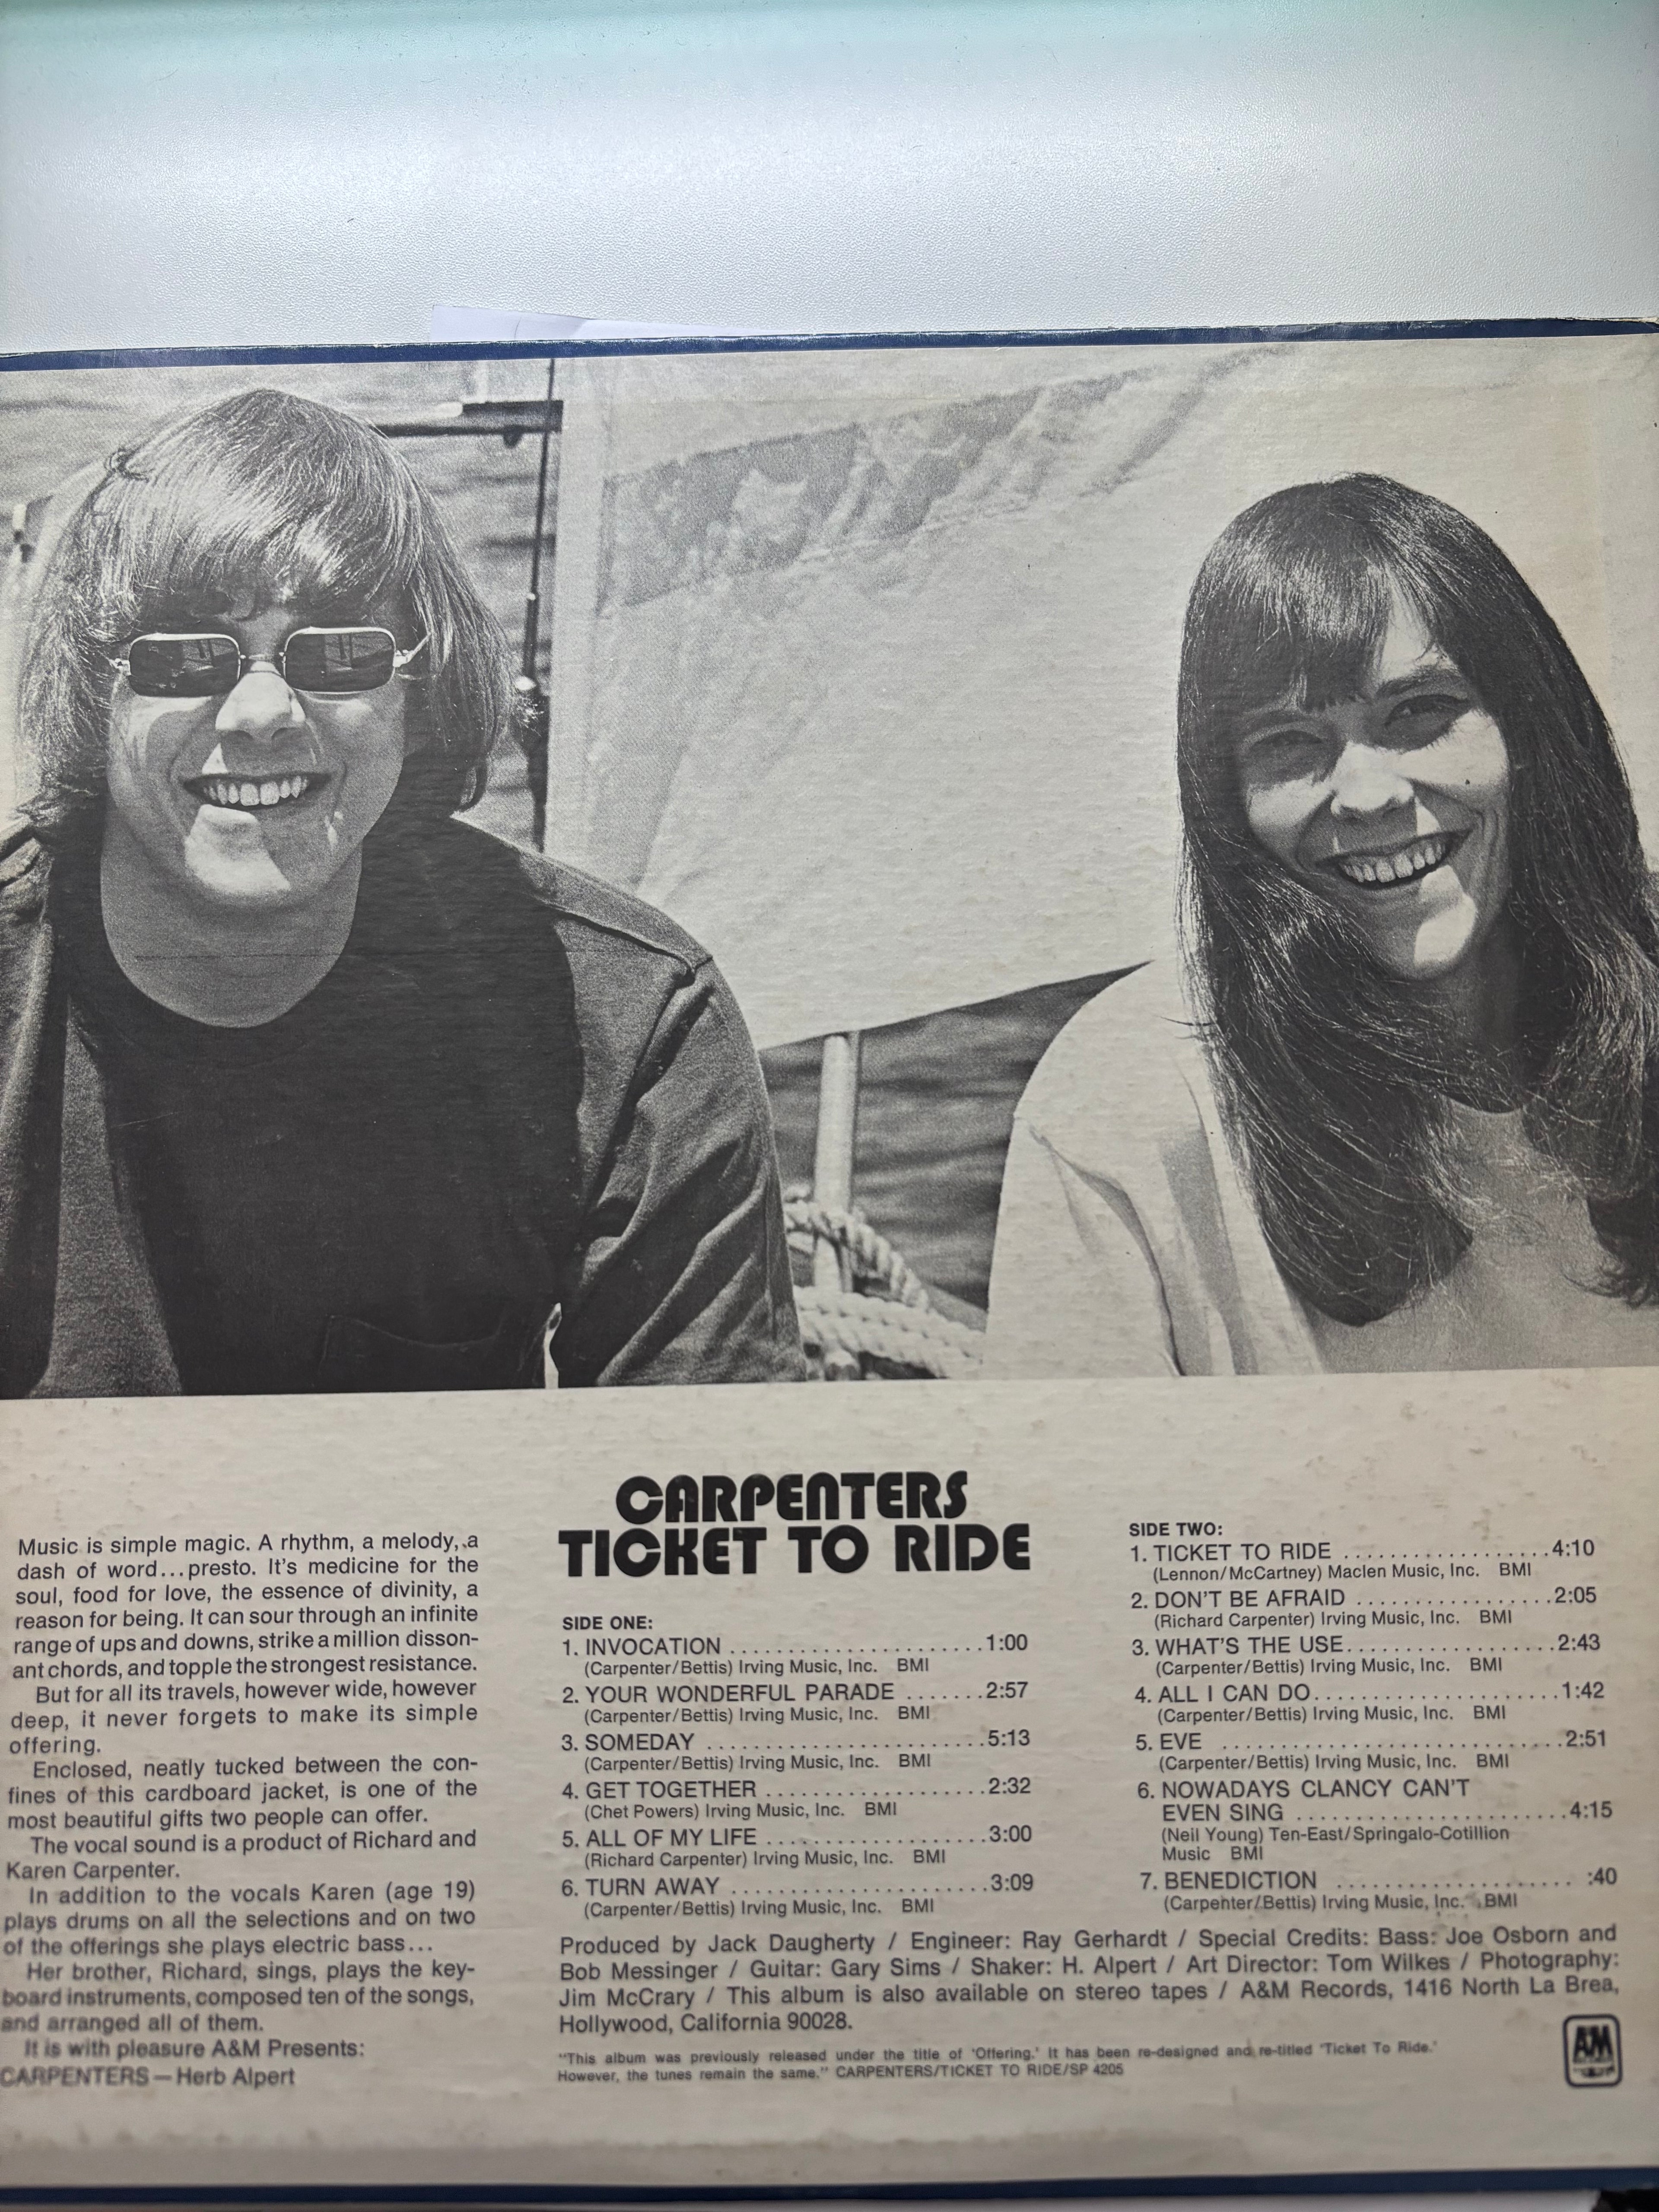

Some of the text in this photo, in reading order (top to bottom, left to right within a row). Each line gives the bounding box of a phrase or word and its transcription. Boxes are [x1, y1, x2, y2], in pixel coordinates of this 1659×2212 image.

[616, 1471, 967, 1525] CARPENTERS
[1129, 1522, 1223, 1537] SIDE TWO:
[19, 1531, 478, 1557] Music is simple magic. A rhythm, a melody, a
[558, 1523, 1030, 1577] TICKET TO RIDE
[1131, 1539, 1595, 1562] 1. TICKET TO RIDE 4:10
[1328, 1564, 1386, 1579] Maclen
[1392, 1563, 1444, 1580] Music,
[1450, 1563, 1479, 1577] Inc.
[1499, 1562, 1531, 1576] BMI
[1131, 1586, 1597, 1609] 2. DON'T BE AFRAID 2:05
[15, 1604, 478, 1630] reason for being. It can sour through an infinite
[562, 1615, 653, 1631] SIDE ONE:
[562, 1634, 1028, 1656] 1. INVOCATION 1:00
[1132, 1639, 1149, 1656] 3.
[1155, 1637, 1239, 1656] WHAT'S
[1247, 1636, 1291, 1654] THE
[1558, 1633, 1601, 1651] 2:43
[36, 1679, 477, 1703] But for all its travels, however wide, however
[562, 1681, 1029, 1704] 2. YOUR WONDERFUL PARADE 2:57
[1134, 1686, 1151, 1703] 4.
[1158, 1685, 1199, 1703] ALL
[1208, 1685, 1212, 1702] I
[1223, 1684, 1268, 1702] CAN
[1562, 1681, 1605, 1699] 1:42
[561, 1729, 1030, 1751] 3. SOMEDAY 5:13
[1136, 1729, 1605, 1751] 5. EVE 2:51
[33, 1754, 478, 1780] Enclosed, neatly tucked between the con-
[562, 1777, 1031, 1799] 4. GET TOGETHER 2:32
[1137, 1778, 1470, 1799] 6. NOWADAYS CLANCY CAN'T
[585, 1801, 897, 1822] (Chet Powers) Irving Music, Inc. BMI
[1163, 1800, 1613, 1822] EVEN SING 4:15
[562, 1824, 1032, 1849] 5. ALL OF MY LIFE 3:00
[1162, 1825, 1510, 1845] (Neil Young) Ten-East/Springalo-Cotillion
[30, 1879, 475, 1904] In addition to the vocals Karen (age 19)
[561, 1873, 1034, 1897] 6. TURN AWAY 3:09
[1140, 1872, 1157, 1890] 7.
[1165, 1871, 1316, 1890] BENEDICTION
[561, 1923, 1617, 1958] Produced by Jack Daugherty / Engineer: Ray Gerhardt / Special Credits: Bass: Joe Osborn and
[559, 2011, 853, 2037] Hollywood, California 90028.
[558, 2070, 619, 2083] However,
[627, 2069, 648, 2082] the
[655, 2070, 692, 2081] tunes
[700, 2069, 746, 2081] remain
[753, 2067, 774, 2079] the
[1000, 2064, 1020, 2077] TO
[1093, 2063, 1124, 2076] 4205
